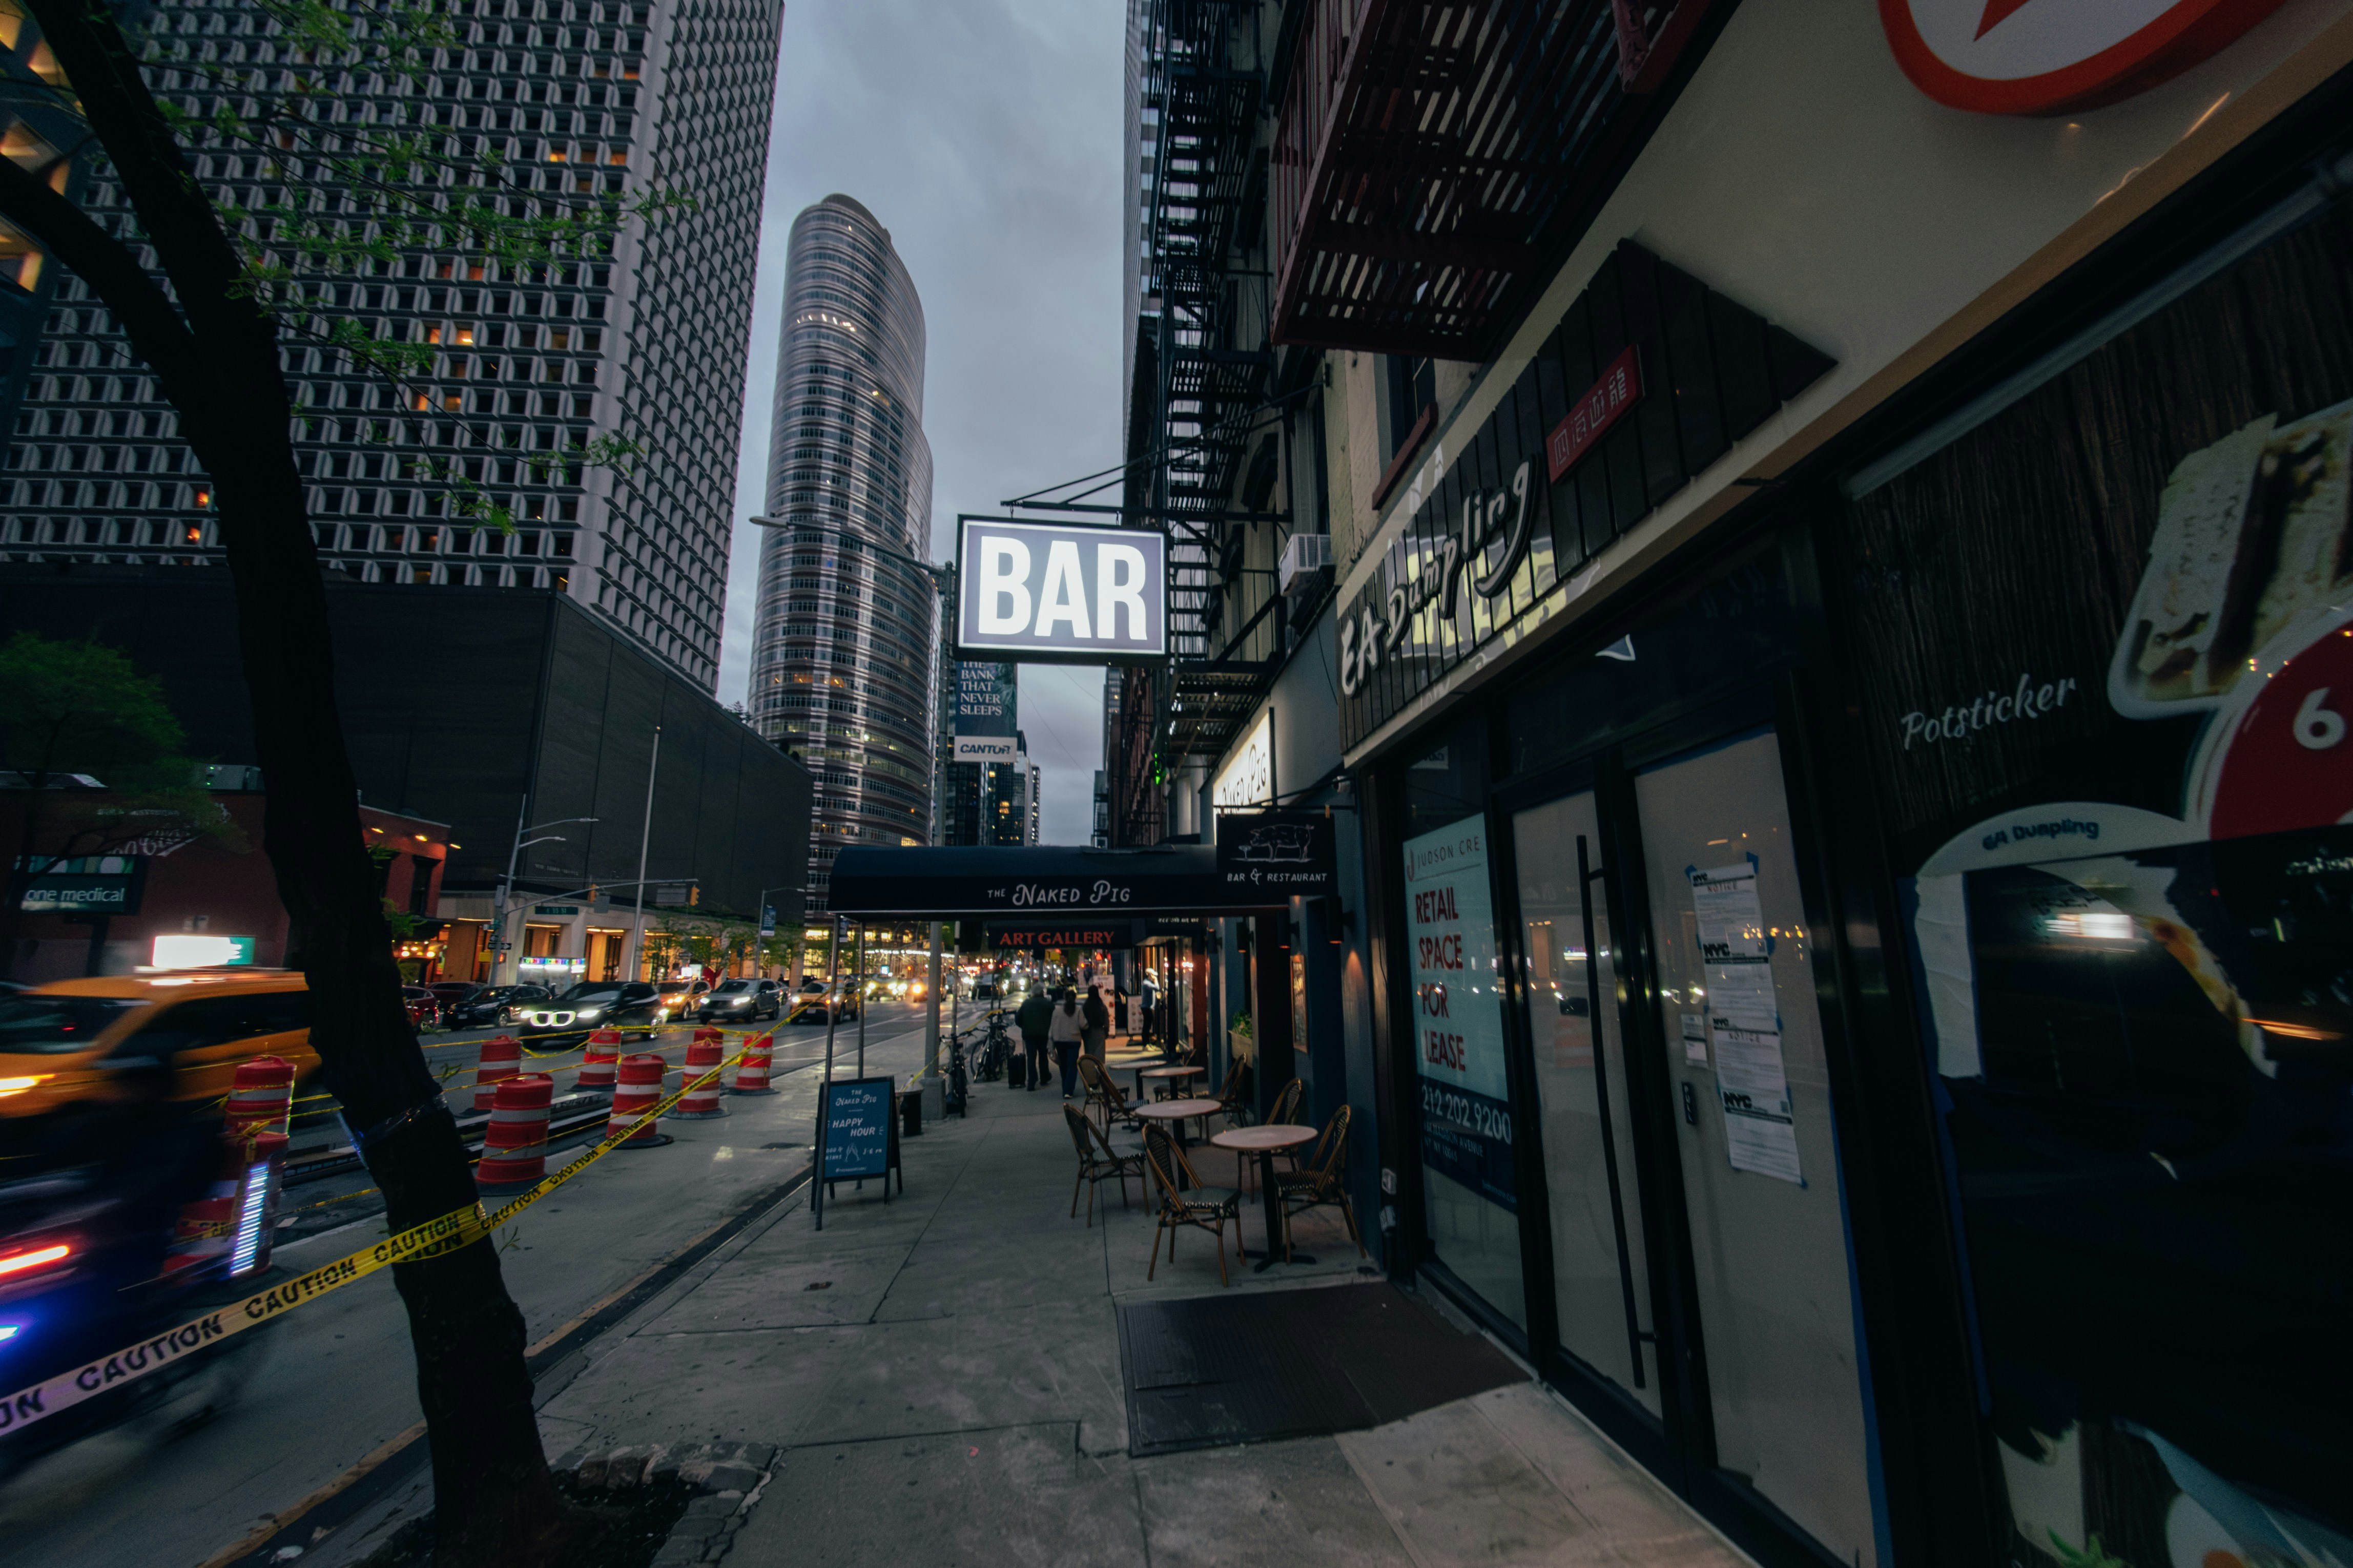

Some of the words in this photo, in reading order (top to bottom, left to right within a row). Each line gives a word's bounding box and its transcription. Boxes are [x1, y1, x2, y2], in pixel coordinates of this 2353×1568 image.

[1386, 460, 1533, 654] Dumpling
[979, 536, 1147, 640] BAR
[961, 669, 995, 680] BANK
[960, 681, 993, 692] THAT
[960, 692, 1001, 704] NEVER
[960, 704, 1002, 716] SLEEPS
[1901, 673, 2076, 750] Potsticker
[2292, 686, 2348, 749] 6
[960, 744, 1010, 755] CANTOR
[1417, 845, 1453, 870] JUDSON
[1459, 836, 1479, 855] CRE
[1227, 873, 1245, 882] BAR
[1250, 868, 1263, 886] &
[1267, 872, 1328, 882] RESTAURANT
[1693, 873, 1707, 882] NYC
[26, 890, 57, 901] one
[60, 887, 125, 902] medical
[987, 888, 1006, 898] THE
[1012, 884, 1080, 906] NAKED
[1089, 880, 1130, 904] PIG
[1415, 886, 1459, 924] RETAIL
[999, 932, 1036, 945] ART
[1037, 931, 1114, 945] GALLERY
[1419, 934, 1463, 969] SPACE
[1703, 943, 1730, 957] NYC
[1422, 983, 1449, 1019] FOR
[1712, 1018, 1728, 1026] NYC
[1425, 1030, 1466, 1072] LEASE
[835, 1098, 860, 1106] NAKED
[1723, 1092, 1752, 1109] NYC
[832, 1118, 863, 1128] HAPPY
[1422, 1084, 1443, 1117] 212
[1446, 1093, 1471, 1127] 202
[1474, 1102, 1512, 1145] 9200
[850, 1127, 876, 1137] HOUR
[1460, 1136, 1483, 1158] AVENUE
[480, 1185, 541, 1230] CAUTION
[549, 1149, 598, 1185] CAUTION
[76, 1314, 223, 1391] CAUTION
[245, 1258, 357, 1318] CAUTION
[374, 1214, 460, 1262] CAUTION
